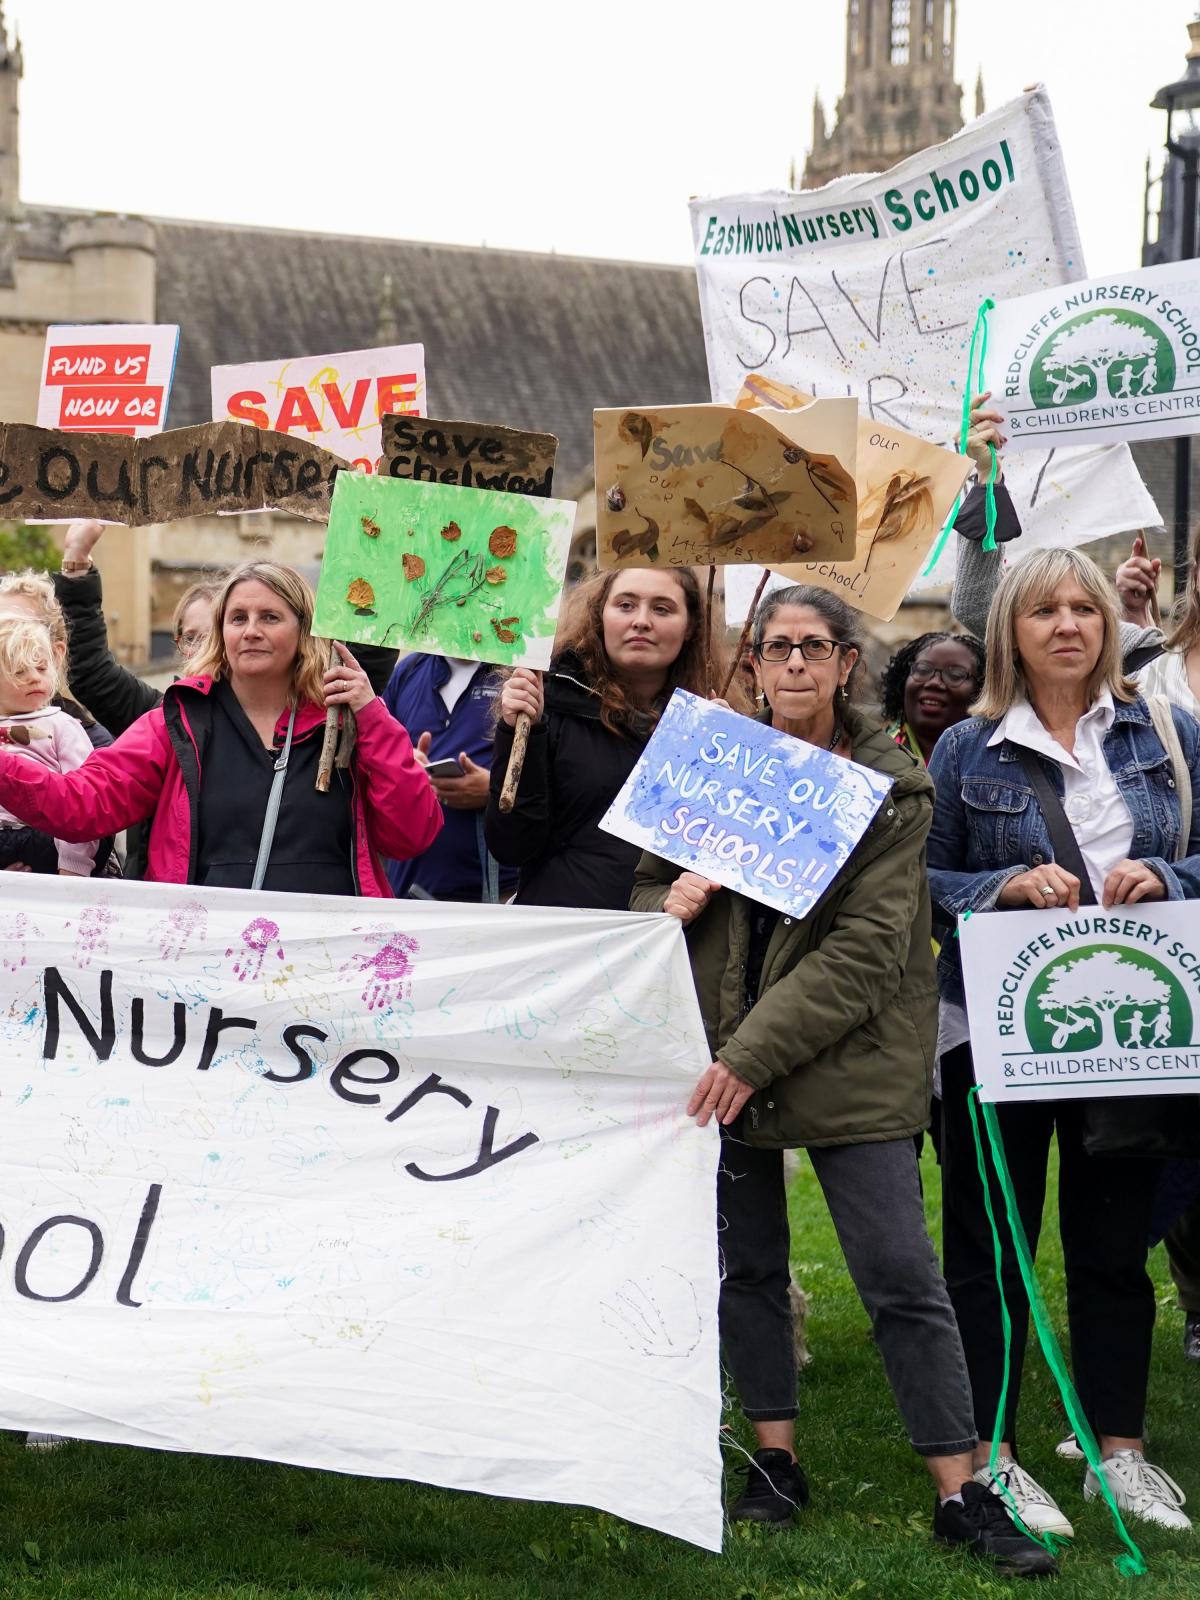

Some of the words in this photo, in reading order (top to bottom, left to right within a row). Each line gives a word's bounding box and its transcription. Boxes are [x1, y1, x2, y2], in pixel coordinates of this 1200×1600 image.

[700, 211, 783, 256] Eastwood
[783, 205, 880, 248] Nursery
[884, 139, 1016, 231] School
[736, 238, 969, 369] SAVE
[1005, 307, 1062, 398] REDCLIFFE
[1065, 285, 1159, 314] NURSERY
[1156, 299, 1200, 374] SCHOOL
[51, 357, 108, 377] FUND
[114, 355, 147, 375] US
[65, 397, 120, 418] NOW
[124, 397, 157, 417] OR
[227, 373, 420, 433] SAVE
[394, 421, 505, 464] Save
[1011, 417, 1022, 429] &
[1025, 405, 1130, 429] CHILDREN'S
[655, 760, 810, 846] NURSERY
[700, 733, 784, 787] SAVE
[788, 778, 852, 822] OUR
[660, 806, 828, 897] SCHOOLS!!
[997, 933, 1055, 1036] REDCLIFFE
[1056, 917, 1169, 947] NURSERY
[1167, 942, 1200, 994] SCH
[43, 966, 541, 1182] Nursery
[1004, 1063, 1016, 1077] &
[1020, 1055, 1140, 1076] CHILDREN'S
